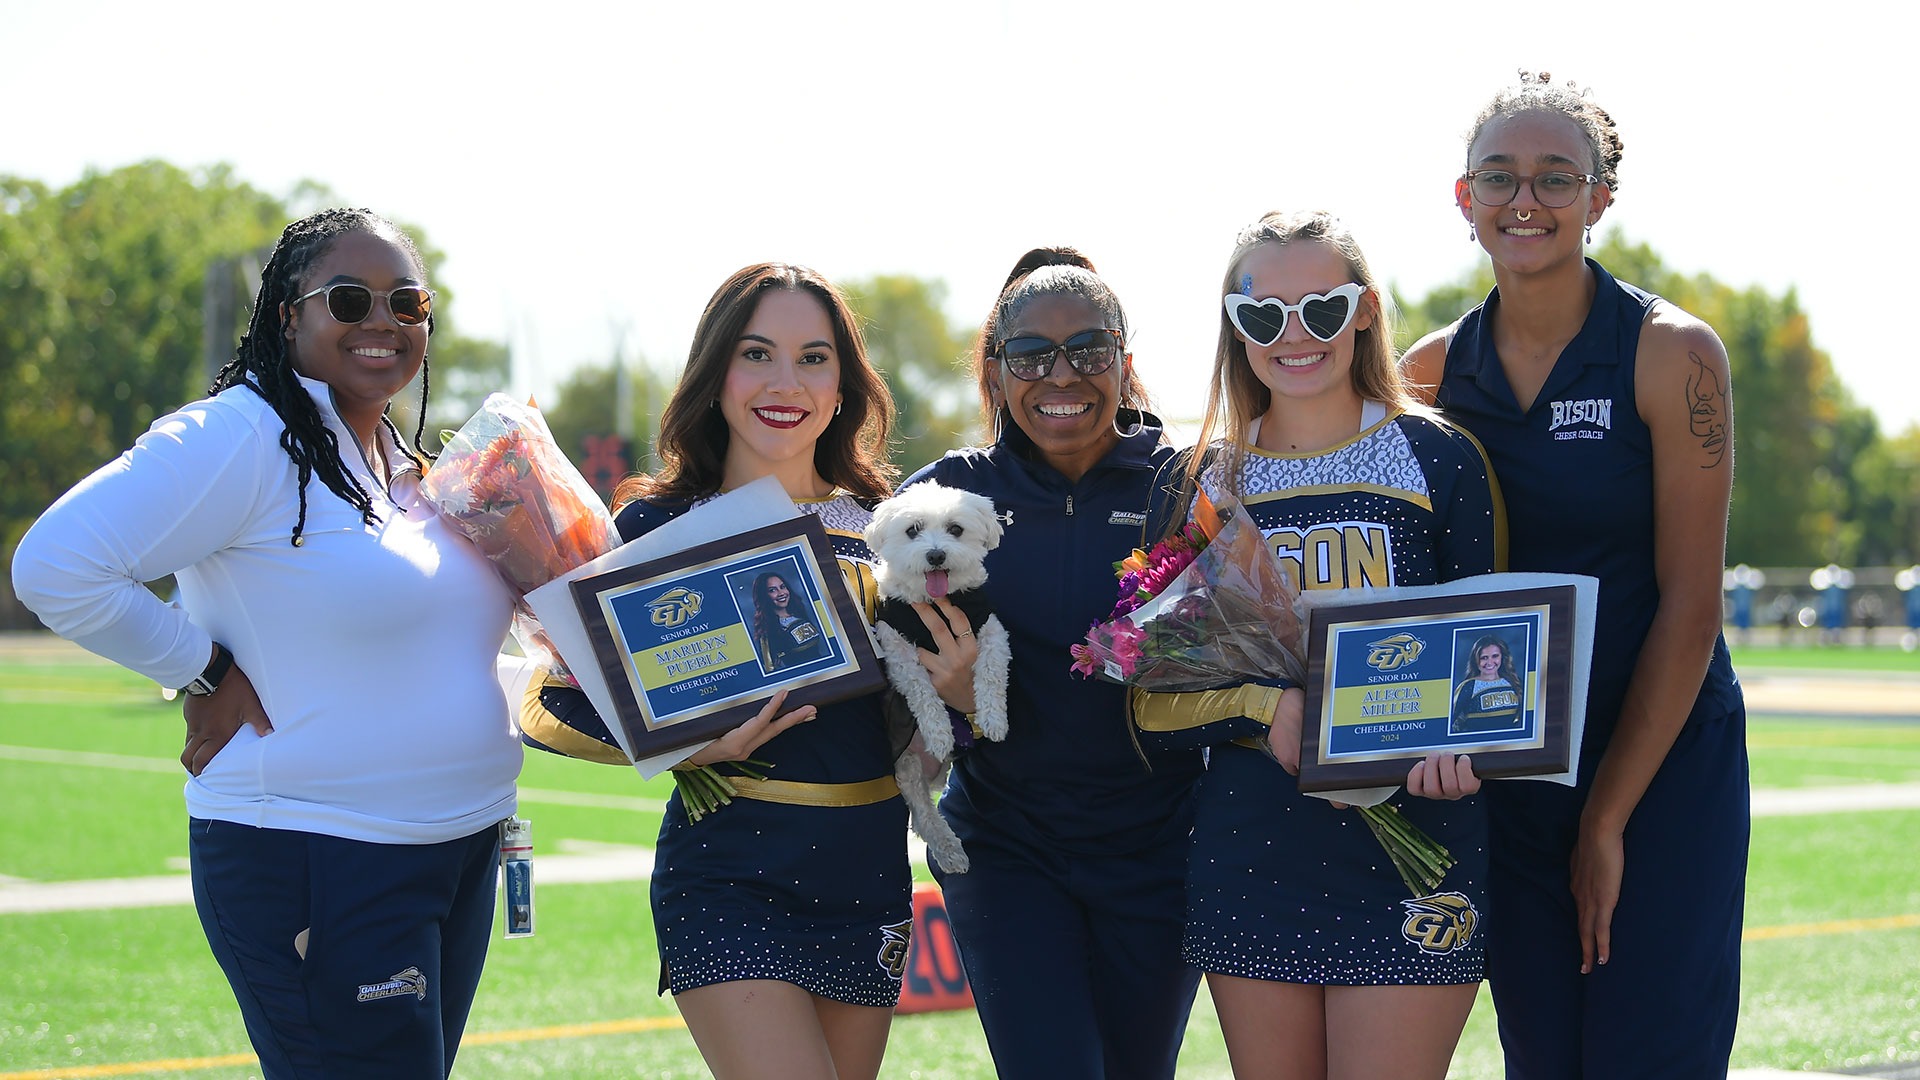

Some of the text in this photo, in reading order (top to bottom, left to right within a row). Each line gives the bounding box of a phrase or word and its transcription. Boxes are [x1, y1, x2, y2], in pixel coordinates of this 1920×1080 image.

[1549, 399, 1612, 431] BISON
[1554, 430, 1603, 440] CHEER COACH
[1112, 511, 1147, 520] GALLAUD
[1263, 524, 1393, 592] SON
[660, 622, 710, 643] SENIOR DAY
[655, 634, 727, 665] MARILYN
[665, 651, 729, 677] PUEBLA
[669, 668, 739, 694] CHEERLEADING
[1368, 672, 1420, 684] SENIOR DAY
[699, 685, 719, 696] 2024
[1363, 687, 1421, 702] ALECIA
[1360, 701, 1422, 718] MILLER
[1354, 721, 1426, 735] CHEERLEADING
[1380, 734, 1400, 742] 2024
